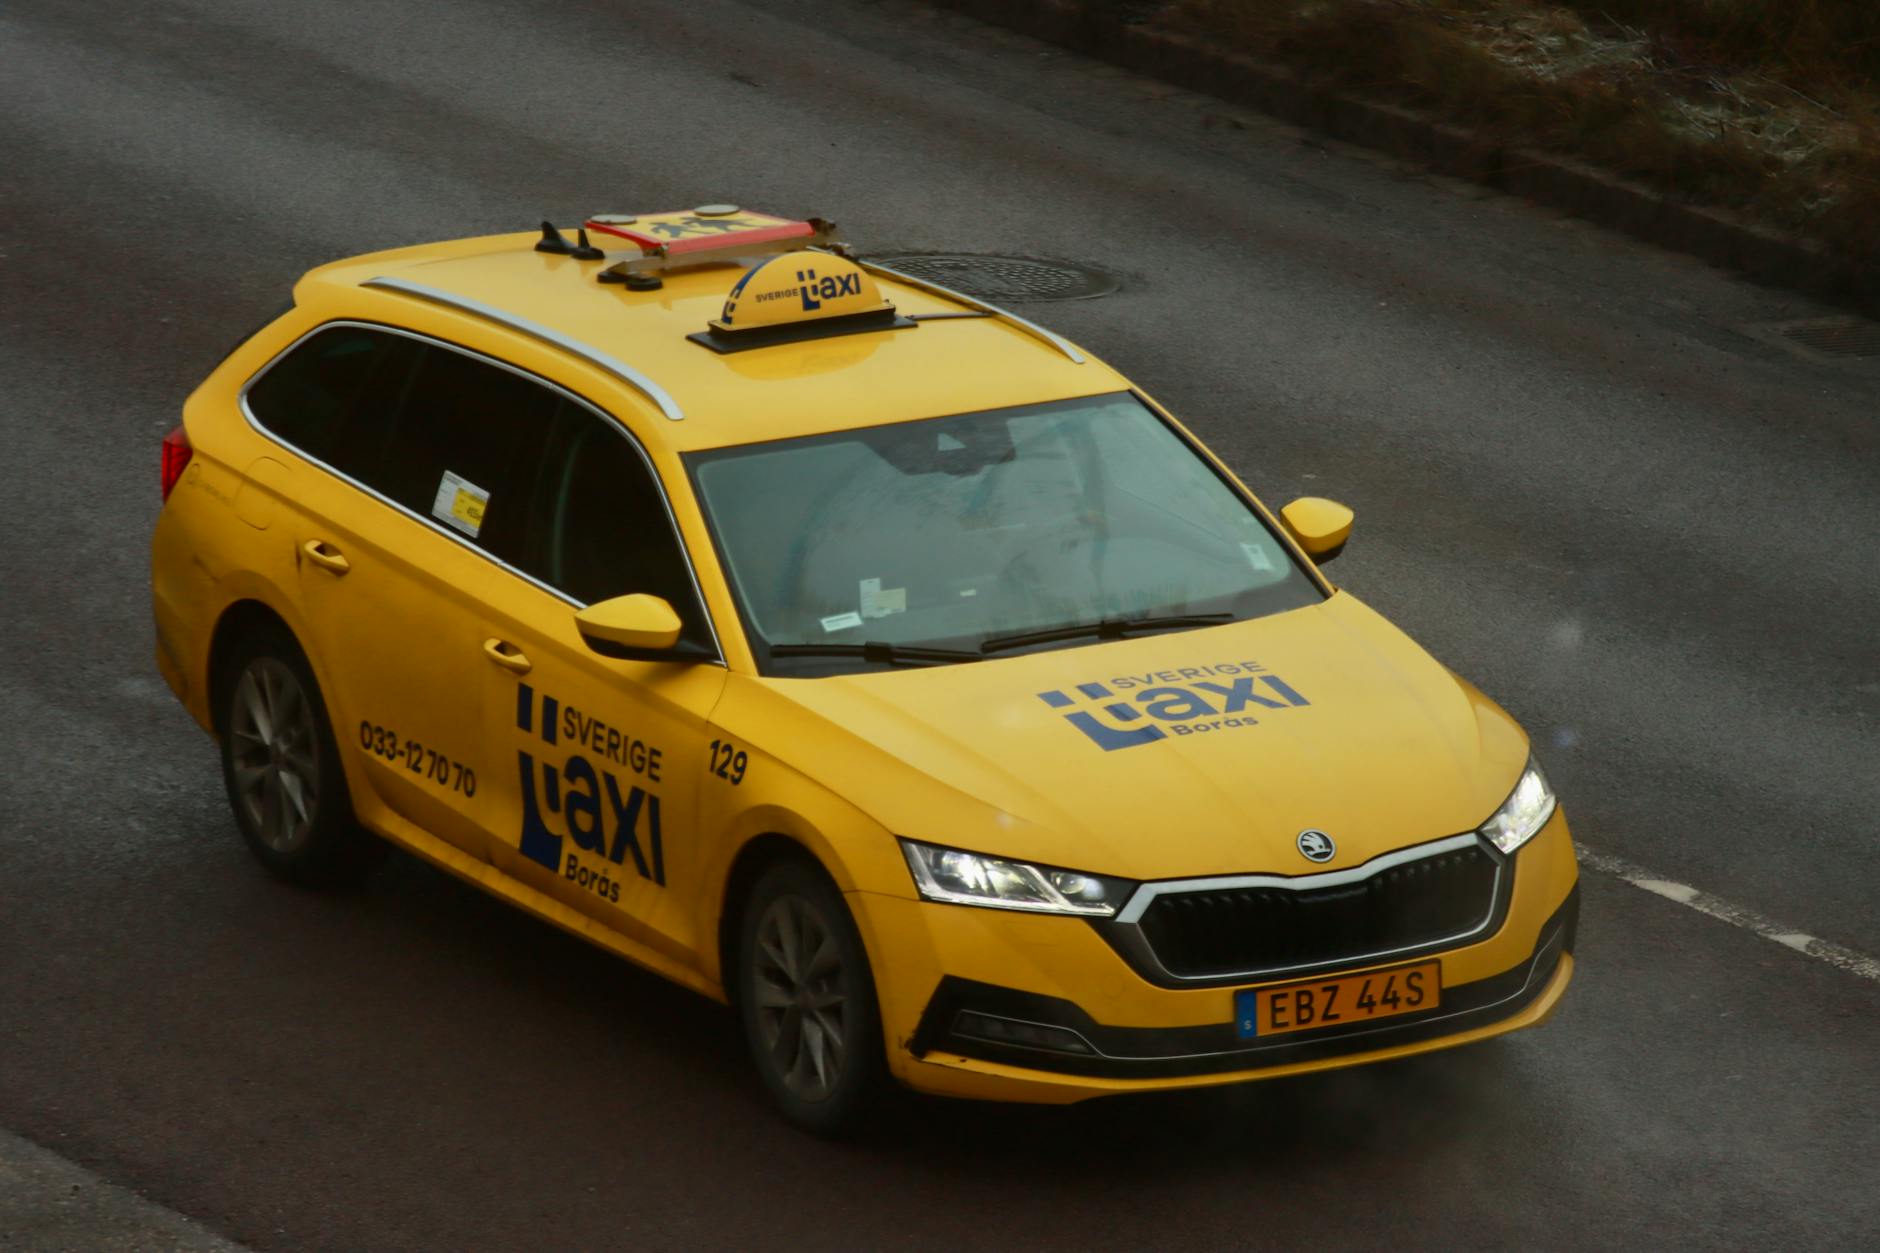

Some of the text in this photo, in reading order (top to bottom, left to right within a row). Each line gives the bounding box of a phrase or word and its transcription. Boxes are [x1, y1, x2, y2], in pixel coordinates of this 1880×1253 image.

[755, 288, 800, 304] SVERIGE
[1110, 660, 1269, 690] SVERIGE
[562, 705, 663, 784] SVERIGE
[1171, 715, 1260, 737] Borås
[359, 720, 477, 798] 033-12 70 70
[708, 738, 748, 786] 129
[564, 852, 622, 905] Borås
[1270, 971, 1425, 1029] EBZ 44S
[1243, 1019, 1253, 1031] S
